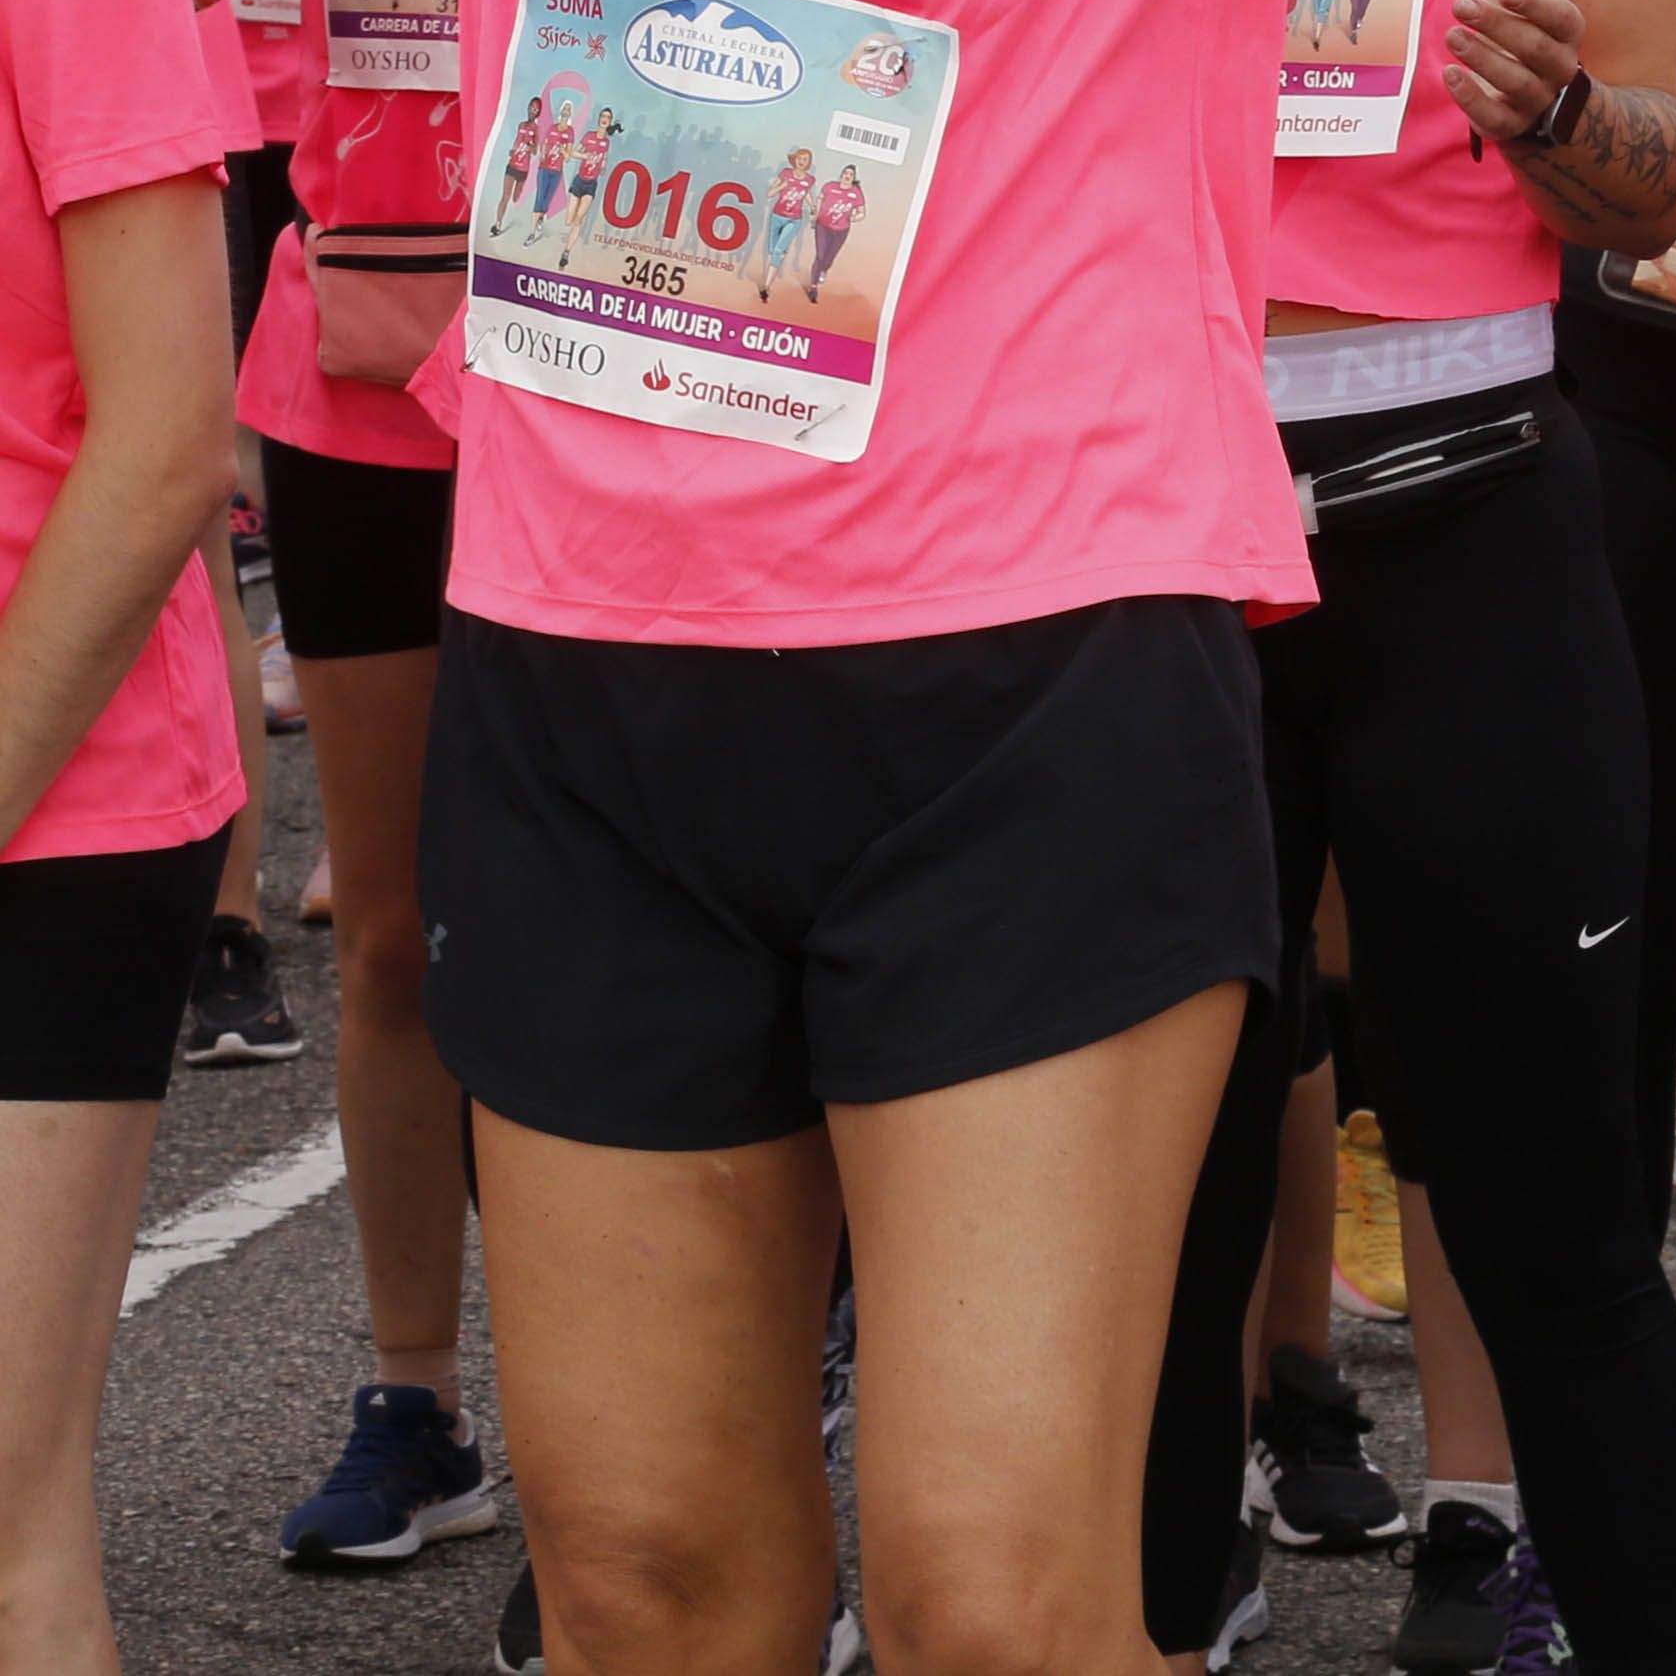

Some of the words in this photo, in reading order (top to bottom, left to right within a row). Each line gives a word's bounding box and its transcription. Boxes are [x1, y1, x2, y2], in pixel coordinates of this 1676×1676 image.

[361, 17, 419, 33] CARRERA
[424, 19, 440, 34] DE
[662, 23, 715, 45] CENTRAL
[721, 37, 786, 60] LECHERA
[352, 50, 431, 72] OYSHO
[632, 23, 784, 91] ASTURIANA
[1303, 66, 1355, 89] GIJÓN
[602, 160, 755, 252] 016
[621, 255, 687, 296] 3465
[516, 274, 594, 313] CARRERA
[600, 292, 624, 320] DE
[627, 299, 646, 326] LA
[650, 305, 723, 342] MUJER
[742, 327, 810, 360] GIJÓN
[504, 322, 605, 376] OYSHO
[1330, 316, 1534, 397] NIKE
[675, 371, 818, 422] Santander
